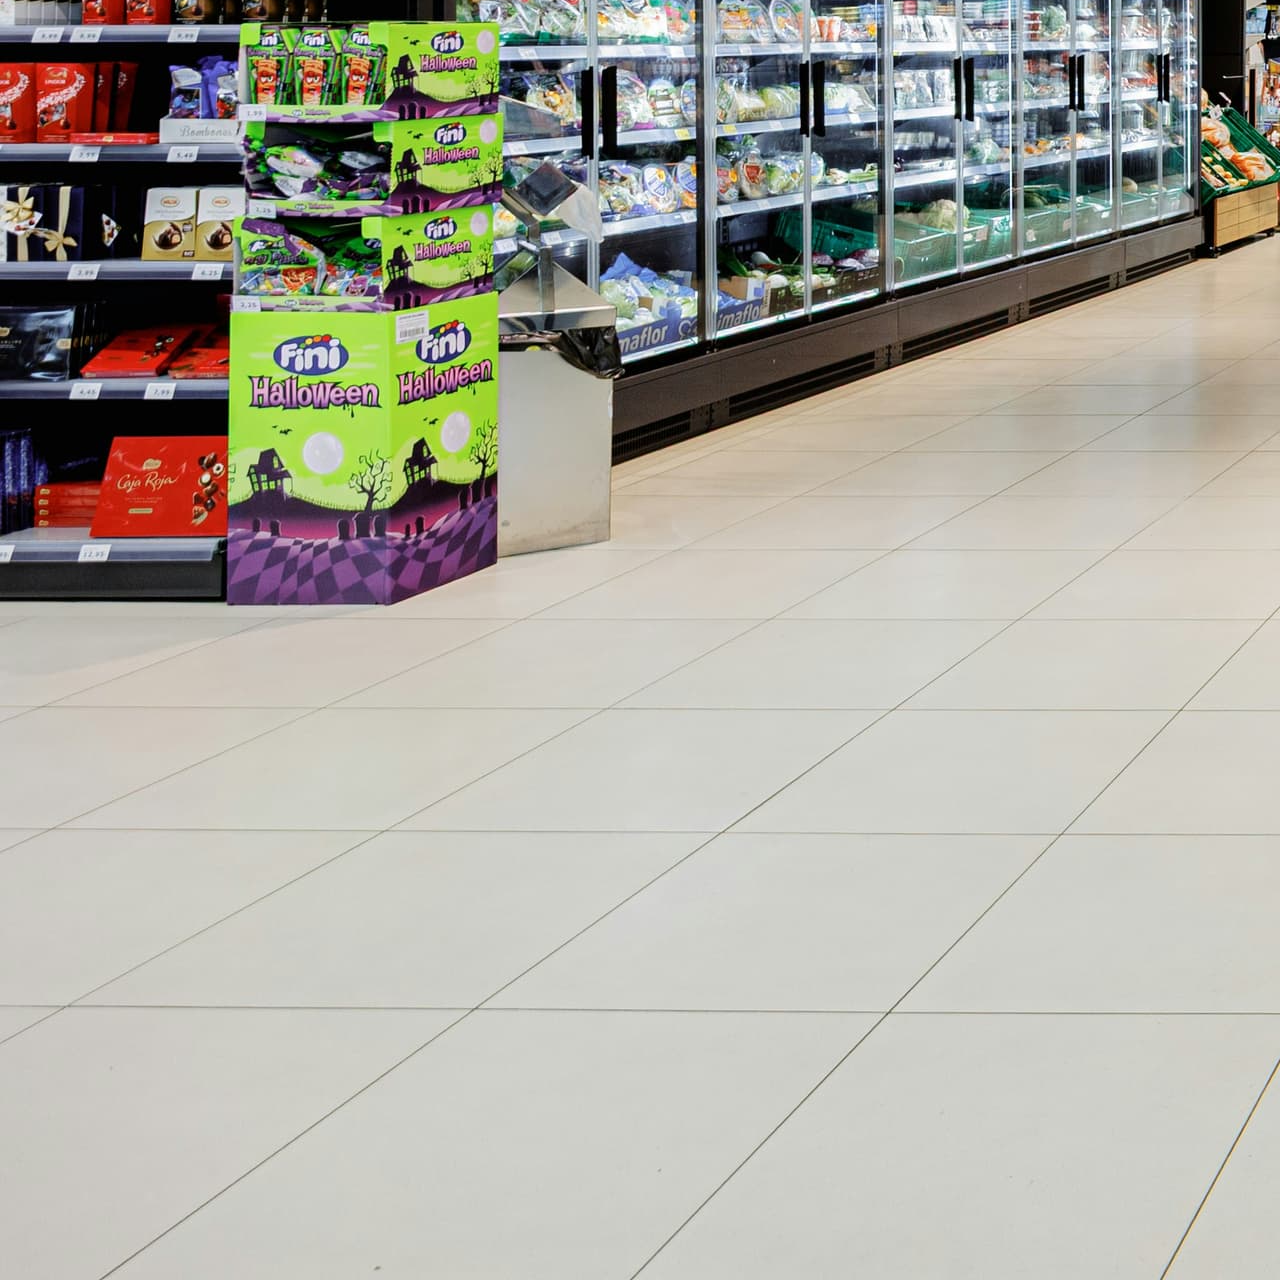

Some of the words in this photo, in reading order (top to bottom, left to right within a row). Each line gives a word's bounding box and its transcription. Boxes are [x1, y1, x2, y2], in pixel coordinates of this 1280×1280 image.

[420, 55, 477, 73] Halloween
[180, 125, 233, 137] Bombones
[423, 146, 480, 166] Halloween
[414, 240, 471, 261] Halloween
[420, 323, 465, 361] Fini
[619, 324, 668, 354] maflor
[280, 338, 341, 371] Fini
[250, 375, 382, 410] Halloween
[398, 359, 493, 405] Halloween
[116, 473, 141, 494] Caja
[145, 471, 178, 493] Roja
